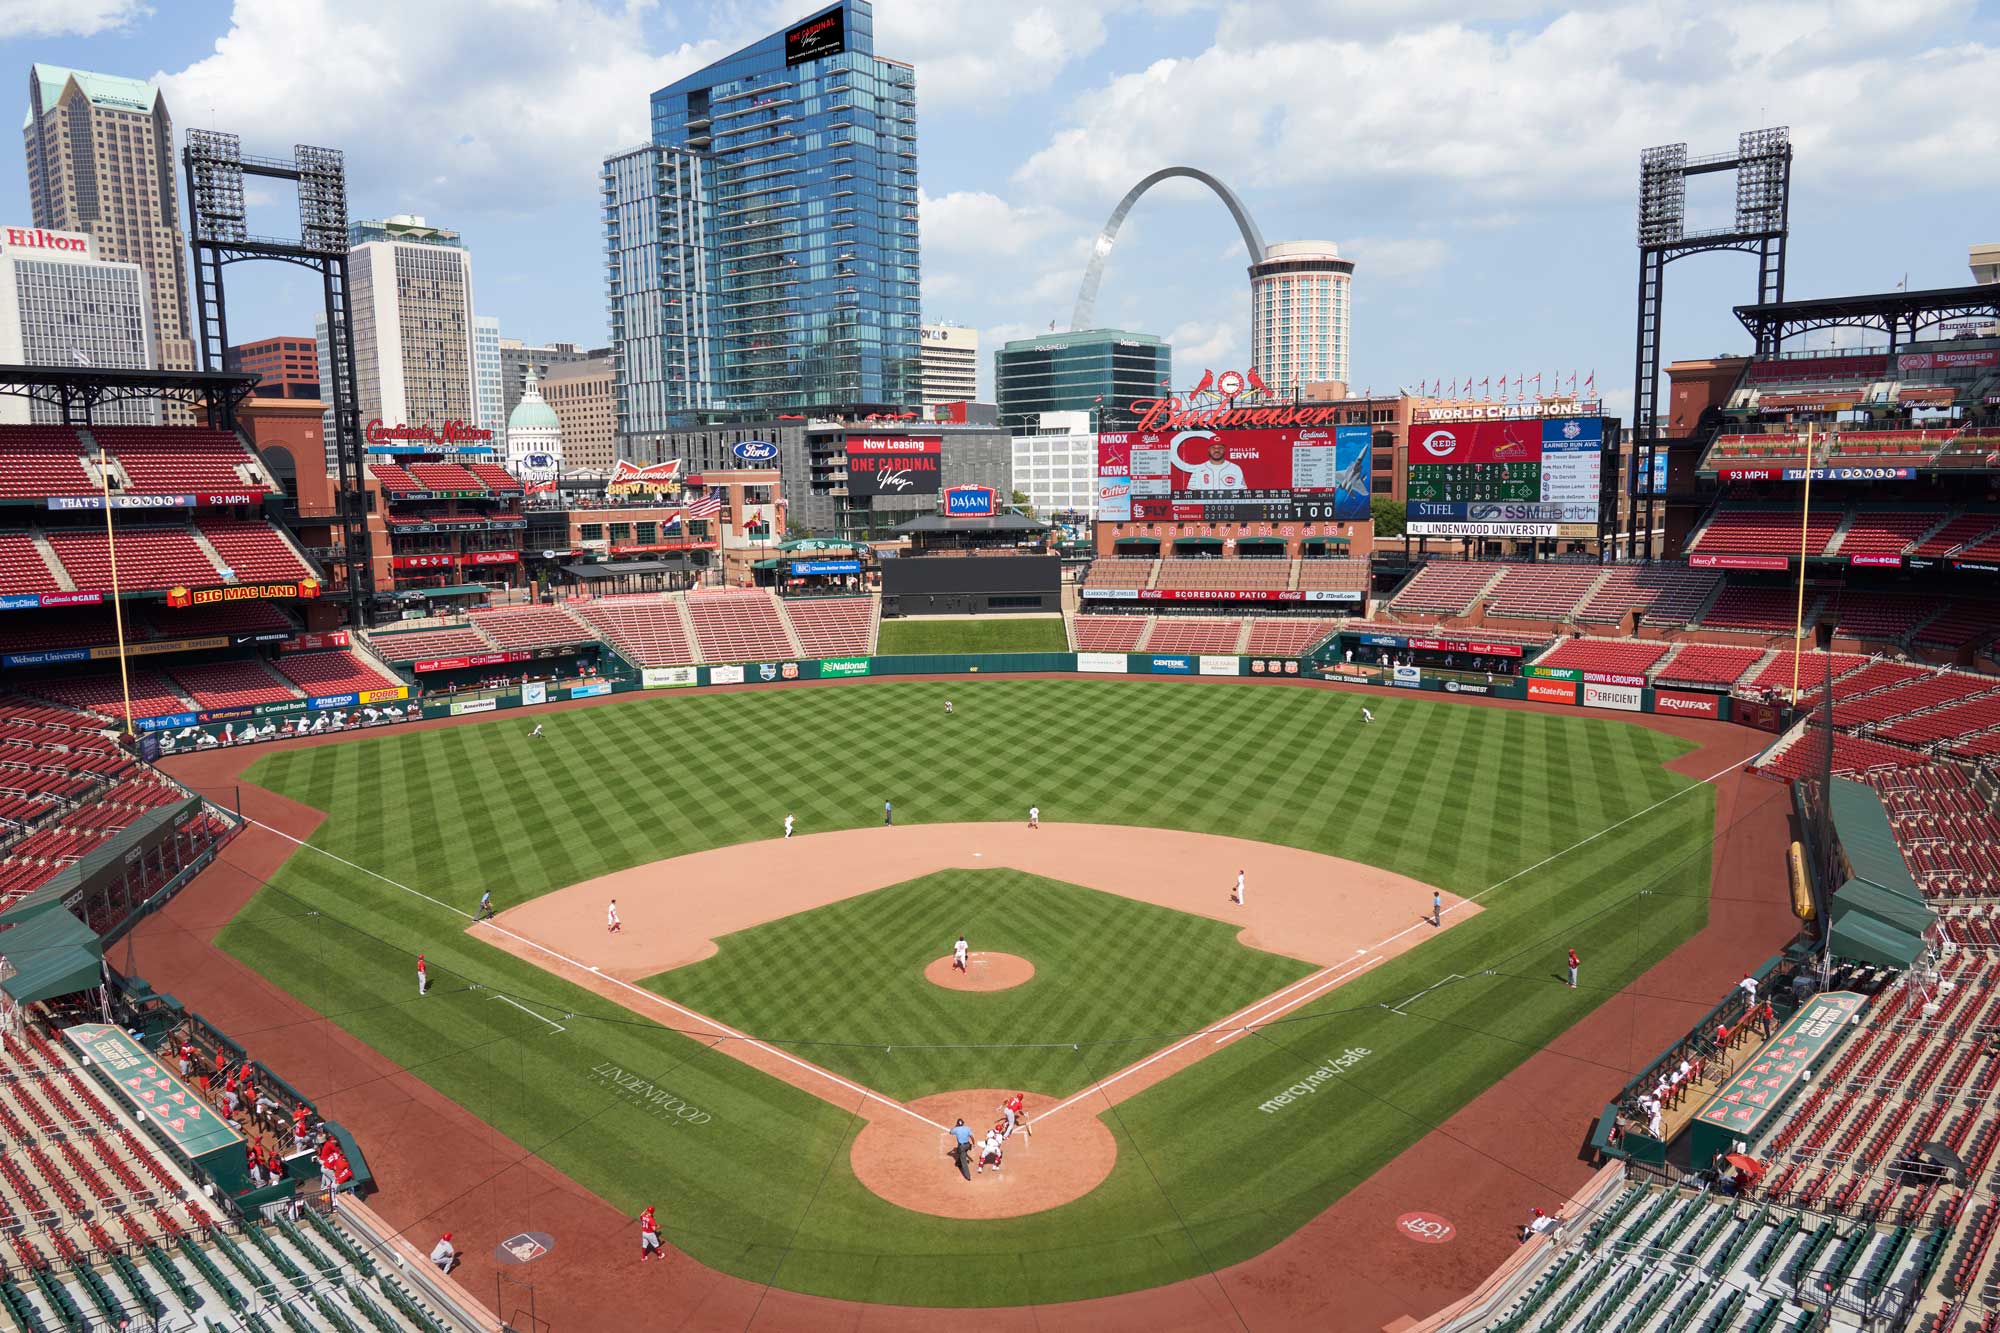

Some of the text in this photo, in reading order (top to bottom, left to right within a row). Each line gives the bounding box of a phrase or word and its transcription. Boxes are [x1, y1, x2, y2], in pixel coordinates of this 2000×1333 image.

[7, 228, 85, 252] Hilton
[1938, 321, 1995, 330] BUDWEISER
[1120, 338, 1141, 346] Deloitte
[1034, 344, 1069, 352] POLSINELLI
[1936, 352, 1994, 362] BUDWEISER
[1130, 398, 1337, 432] Budweiser
[1428, 404, 1582, 420] WORLD CHAMPIONS
[1760, 405, 1795, 414] Budweiser
[366, 418, 492, 445] Cardinals Nation
[1300, 430, 1328, 440] Cardinals
[1100, 434, 1128, 444] KMOX
[1432, 440, 1456, 448] REDS
[424, 446, 459, 454] ROOFTOP
[743, 443, 771, 458] Ford
[863, 438, 924, 452] Now Leasing
[529, 455, 547, 464] FOX
[852, 458, 936, 472] ONE CARDINAL
[520, 471, 559, 481] MIDWEST
[611, 466, 680, 483] Budweiser
[1100, 466, 1128, 475] NEWS
[1744, 471, 1769, 479] MPH
[1828, 470, 1836, 478] A
[1841, 469, 1896, 478] POWER
[876, 466, 914, 491] Way
[608, 482, 682, 494] BREW HOUSE
[1100, 485, 1129, 498] Cutter
[60, 498, 100, 508] THAT'S
[120, 496, 174, 506] POWER
[210, 496, 250, 504] 93 MPH
[950, 496, 988, 508] DASANI
[1145, 506, 1168, 516] FLY
[1296, 507, 1332, 518] 1 0 0
[1419, 502, 1454, 516] STIFEL
[1427, 524, 1552, 536] LINDENWOOD UNIVERSITY
[1692, 557, 1712, 567] Mercy
[1853, 555, 1879, 564] Cardinals
[42, 595, 71, 604] Cardinals
[194, 585, 297, 604] BIG MAC LAND
[334, 636, 346, 646] 14
[11, 655, 44, 663] Webster
[45, 651, 85, 661] University
[832, 661, 868, 672] National
[1533, 668, 1573, 678] SUBWAY
[1343, 676, 1368, 684] STADIUM
[1584, 673, 1605, 682] BROWN
[1612, 675, 1644, 685] CROUPPEN
[369, 688, 399, 699] DOBBS
[1460, 684, 1488, 693] MIDWEST
[315, 695, 352, 706] ATHLETICO
[1585, 688, 1638, 706] PERFICIENT
[265, 701, 307, 714] Central Bank
[464, 702, 495, 710] Ameritrade
[1659, 698, 1712, 710] EQUIFAX
[1258, 1046, 1372, 1114] mercy.net/safe
[592, 1062, 711, 1125] LINDENWOOD
